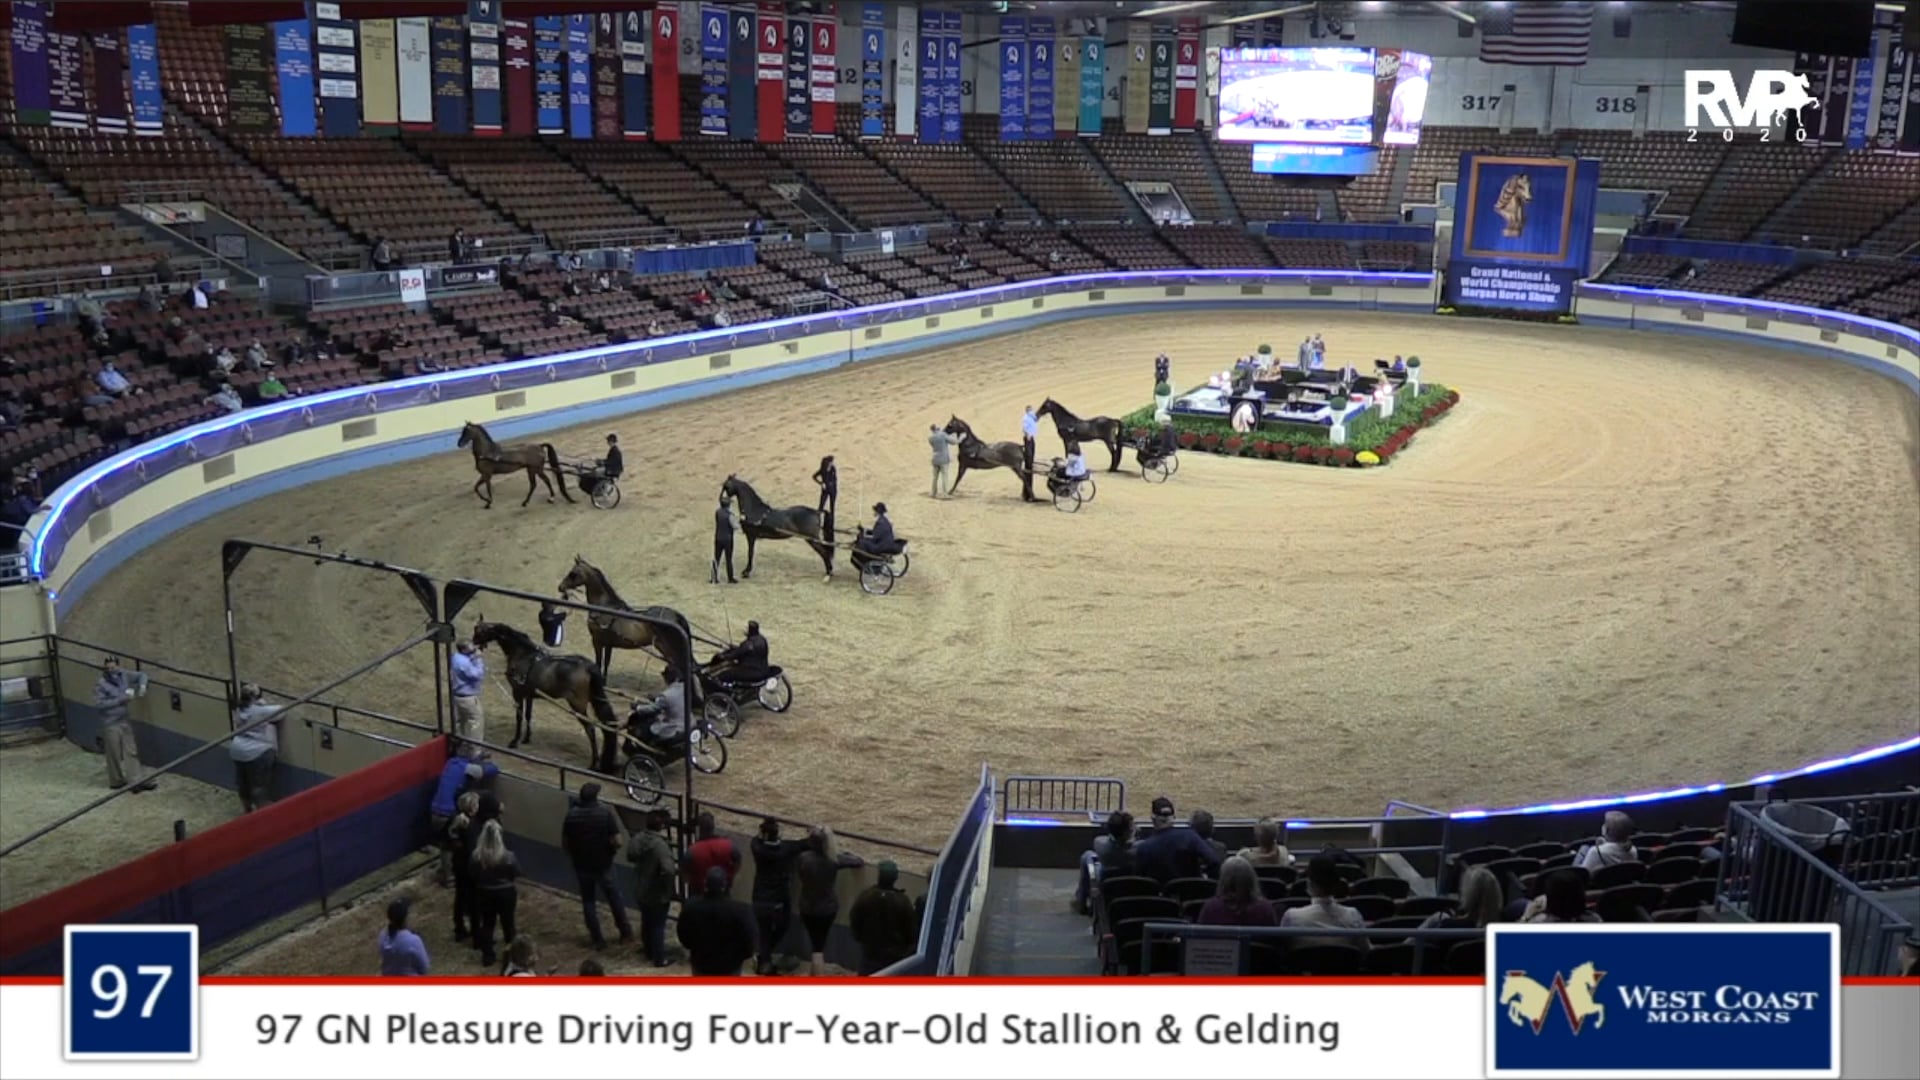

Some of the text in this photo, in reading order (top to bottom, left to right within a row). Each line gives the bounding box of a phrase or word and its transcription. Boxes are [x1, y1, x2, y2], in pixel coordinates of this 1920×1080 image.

[1462, 95, 1501, 111] 317
[1596, 97, 1637, 113] 318
[1471, 266, 1551, 282] Grand National &
[1460, 277, 1561, 294] World Championship
[1461, 288, 1497, 300] Morgan
[1499, 290, 1527, 301] Horse
